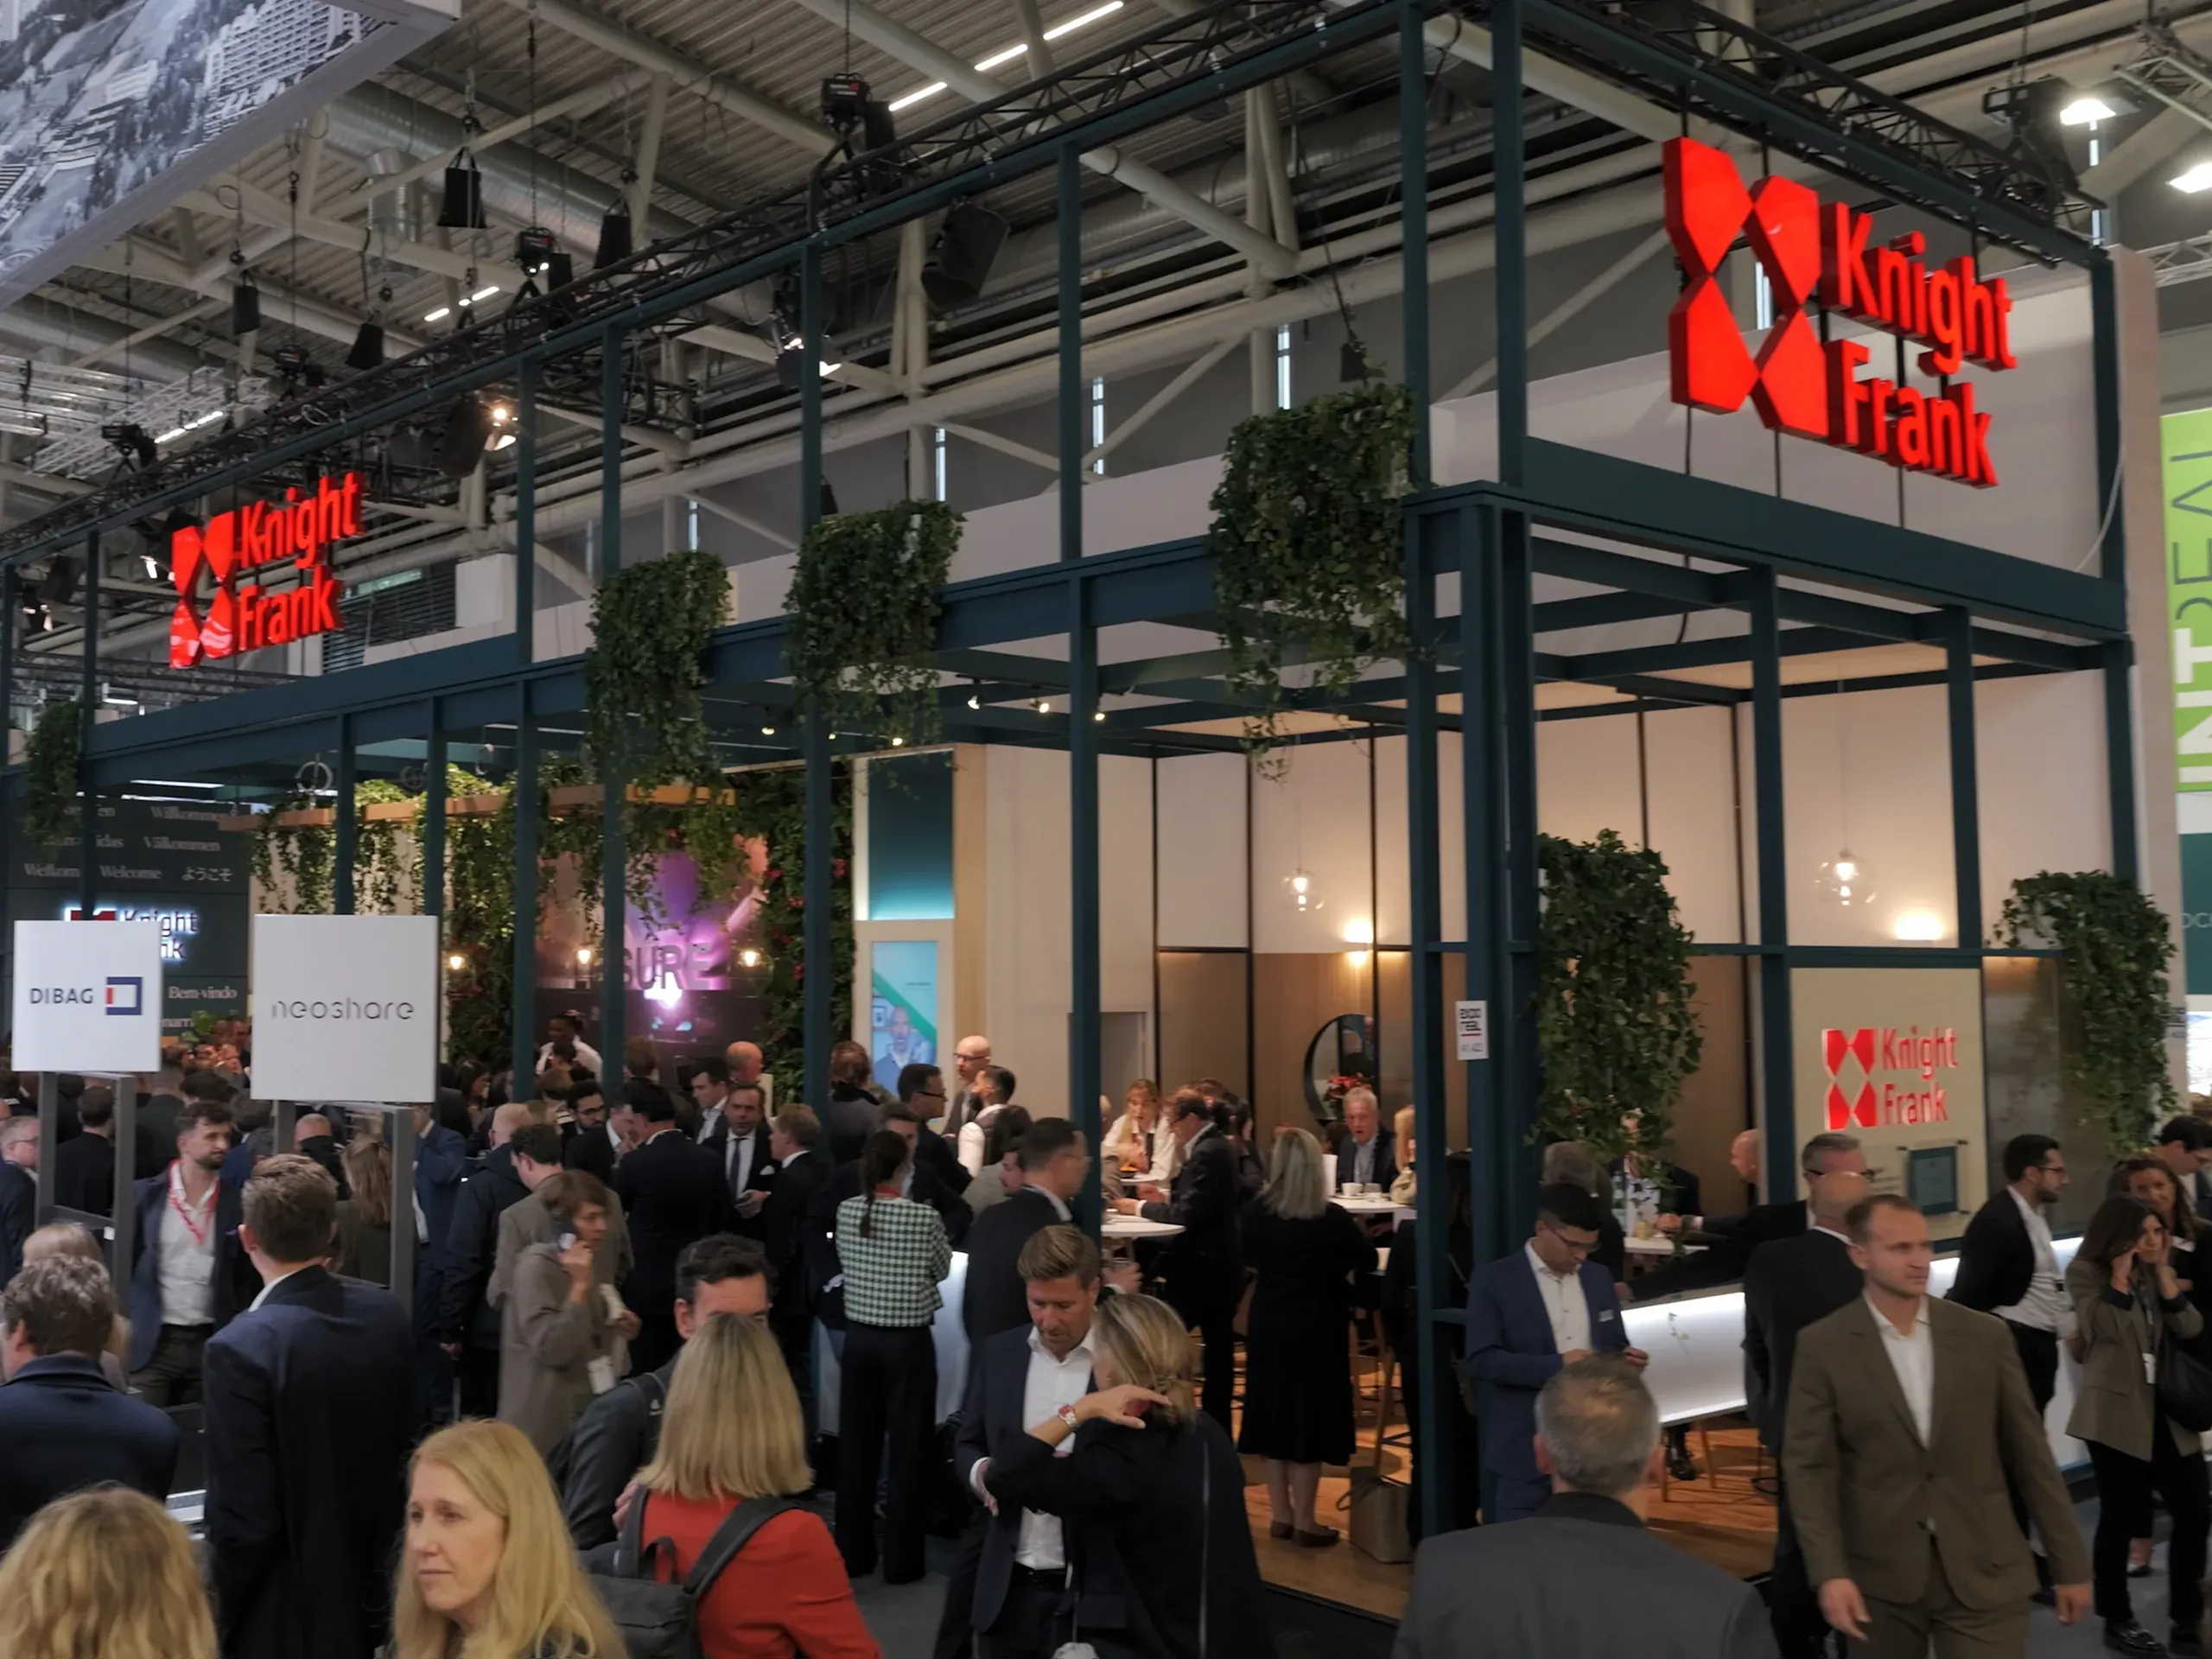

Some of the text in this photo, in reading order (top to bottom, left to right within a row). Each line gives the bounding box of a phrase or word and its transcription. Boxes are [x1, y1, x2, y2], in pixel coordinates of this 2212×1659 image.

[1821, 202, 2018, 377] Knight
[1825, 339, 1998, 489] Frank
[241, 472, 363, 569] Knight
[238, 565, 343, 652] Frank
[99, 866, 162, 880] Welcome
[181, 867, 233, 881] ようこそ
[30, 988, 93, 1004] DIBAG
[272, 997, 415, 1020] neoshare
[1881, 1026, 1958, 1079] Knight
[1883, 1081, 1948, 1125] Frank
